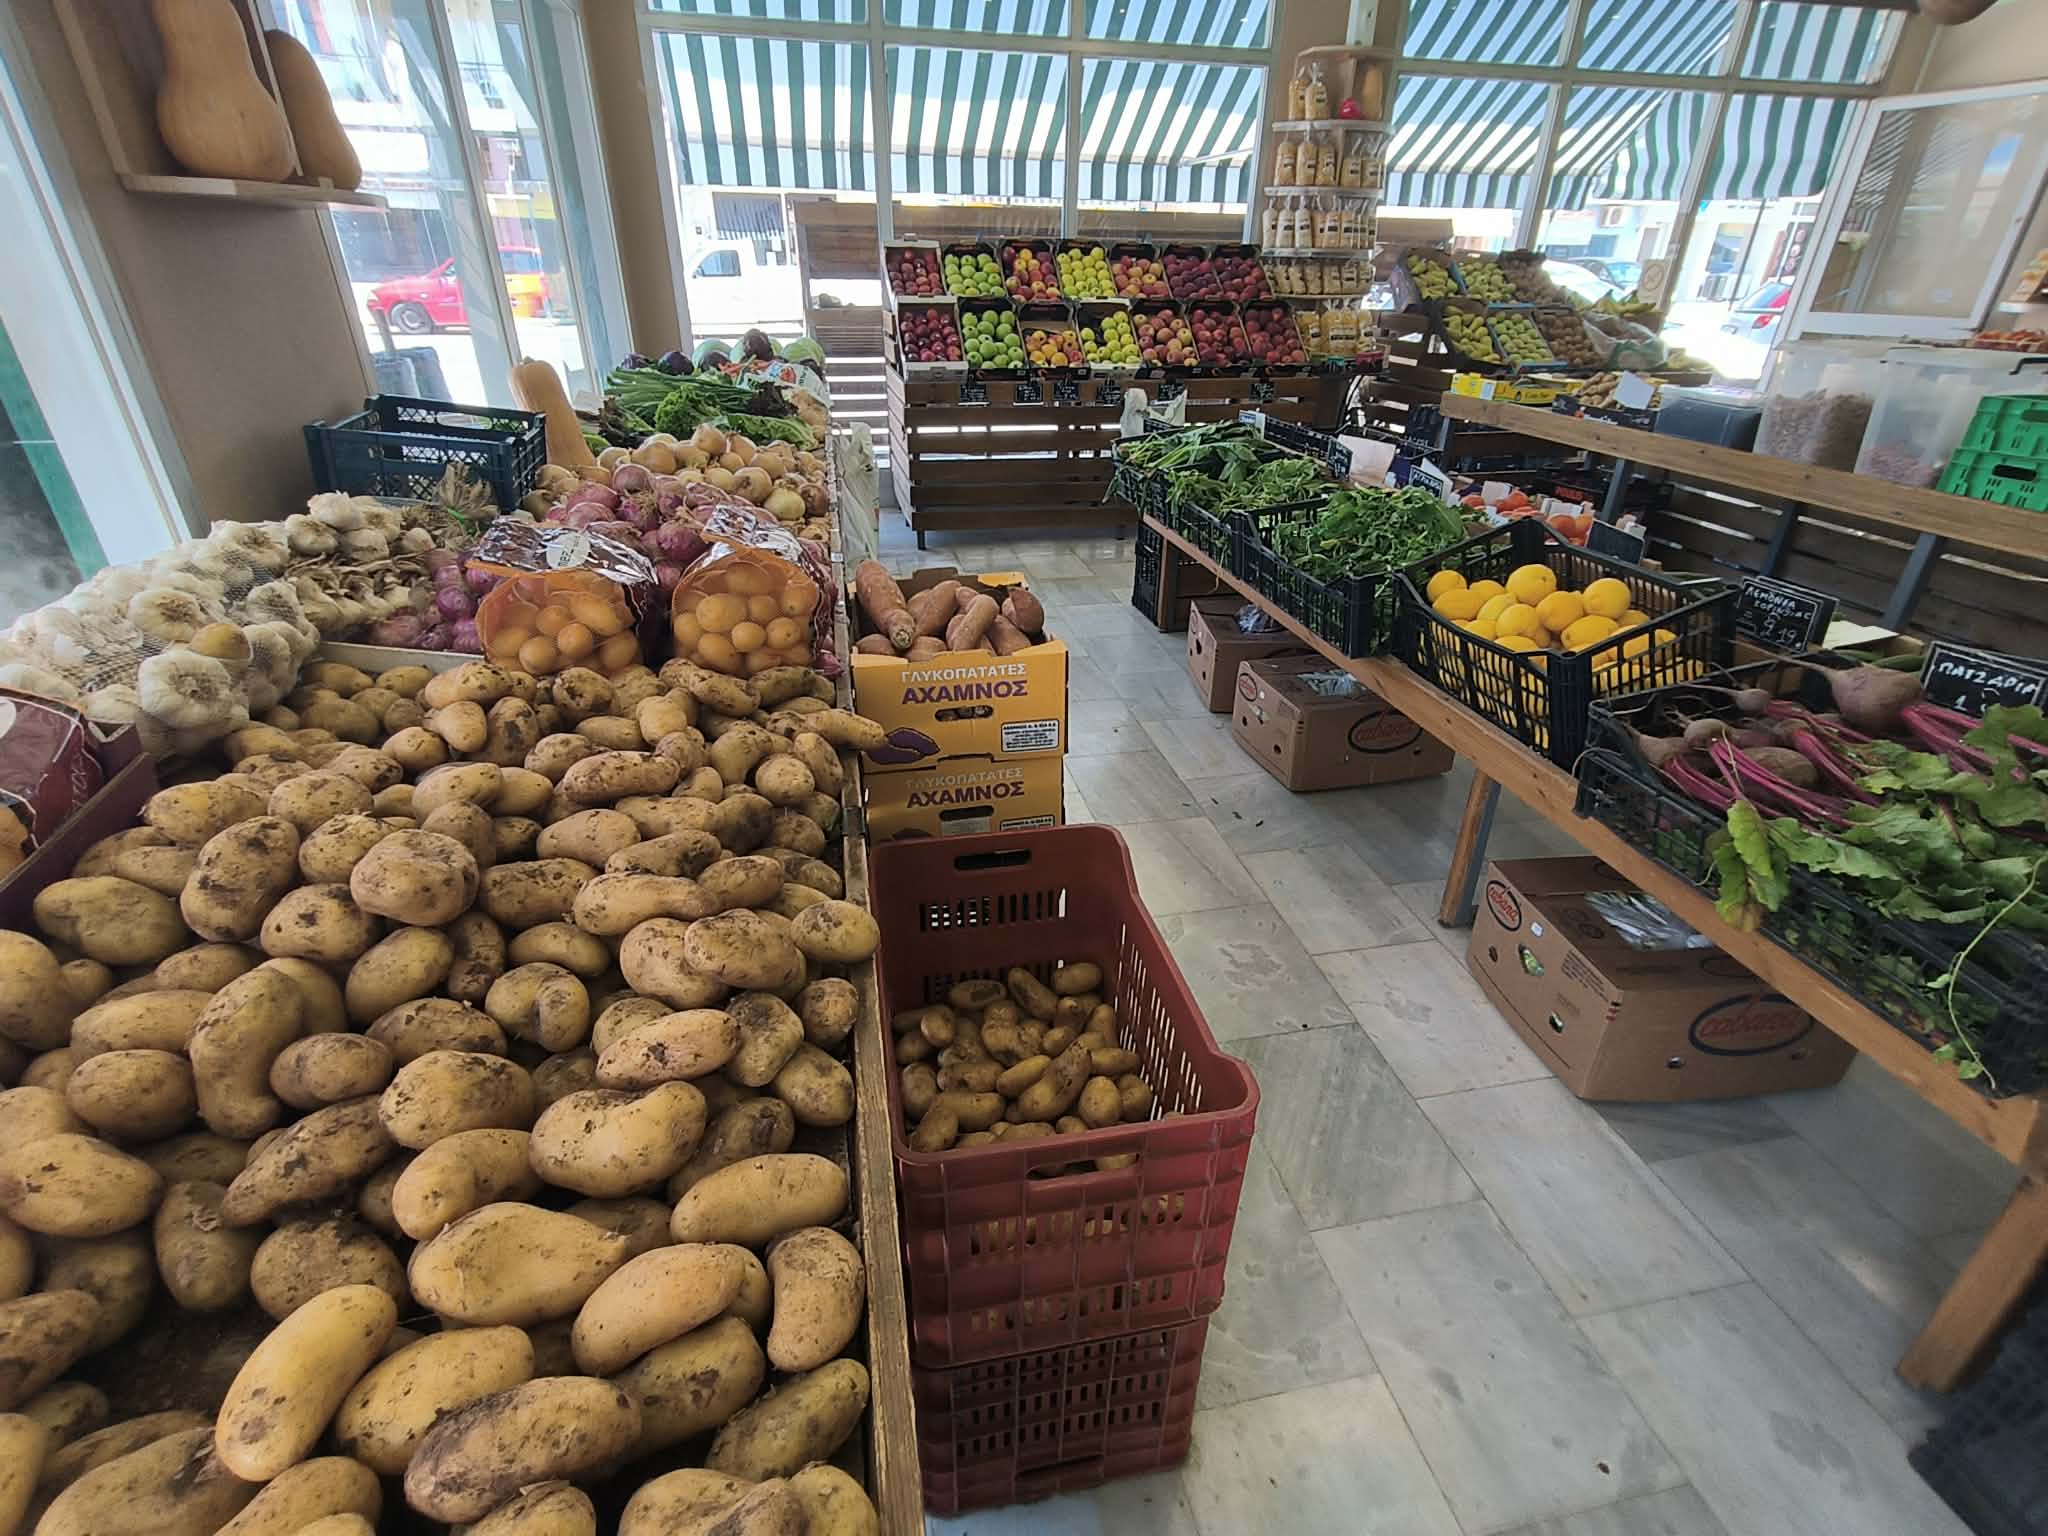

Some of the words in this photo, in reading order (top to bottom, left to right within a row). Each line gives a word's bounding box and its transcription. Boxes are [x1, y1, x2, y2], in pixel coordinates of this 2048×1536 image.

[901, 663, 1027, 682] ΓΛΥΚΟΠΑΤΑΤΕΣ
[902, 680, 1028, 704] ΑΧΑΜΝΟΣ
[907, 781, 1025, 808] ΑΧΑΜΝΟΣ
